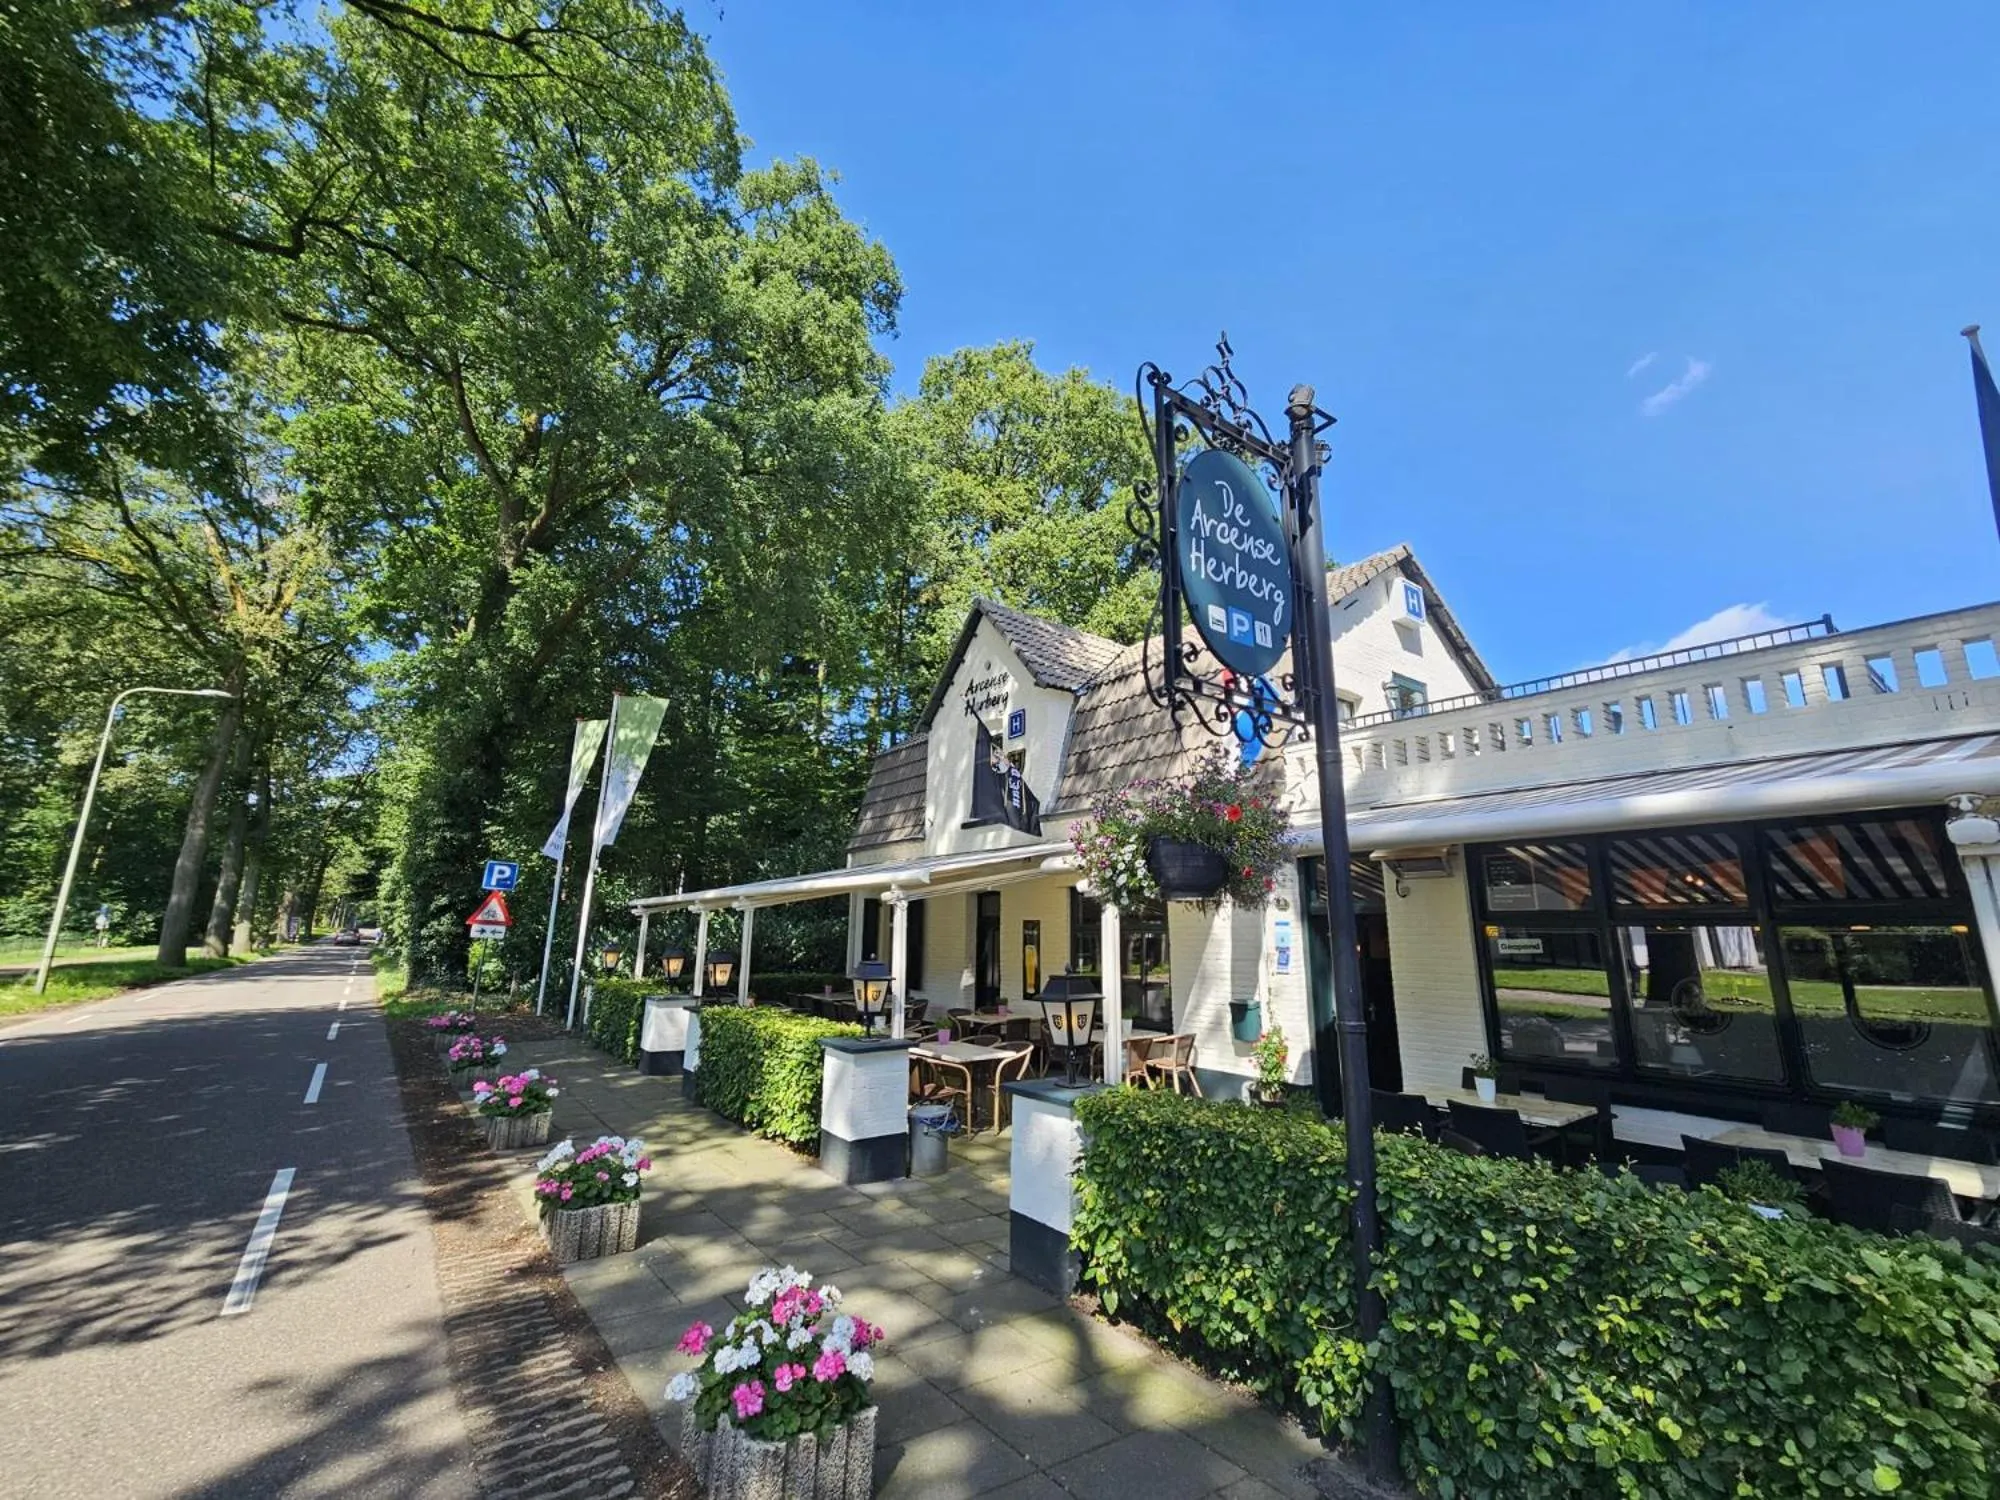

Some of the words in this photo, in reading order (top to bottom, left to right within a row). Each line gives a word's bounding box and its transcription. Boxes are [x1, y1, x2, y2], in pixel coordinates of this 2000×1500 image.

[1215, 481, 1250, 526] De
[1190, 499, 1281, 566] Arcense
[1190, 540, 1284, 625] Herberg
[1408, 590, 1419, 614] H
[1232, 612, 1249, 637] P
[964, 672, 1009, 697] Arcense
[1012, 717, 1020, 732] H
[490, 865, 511, 886] P
